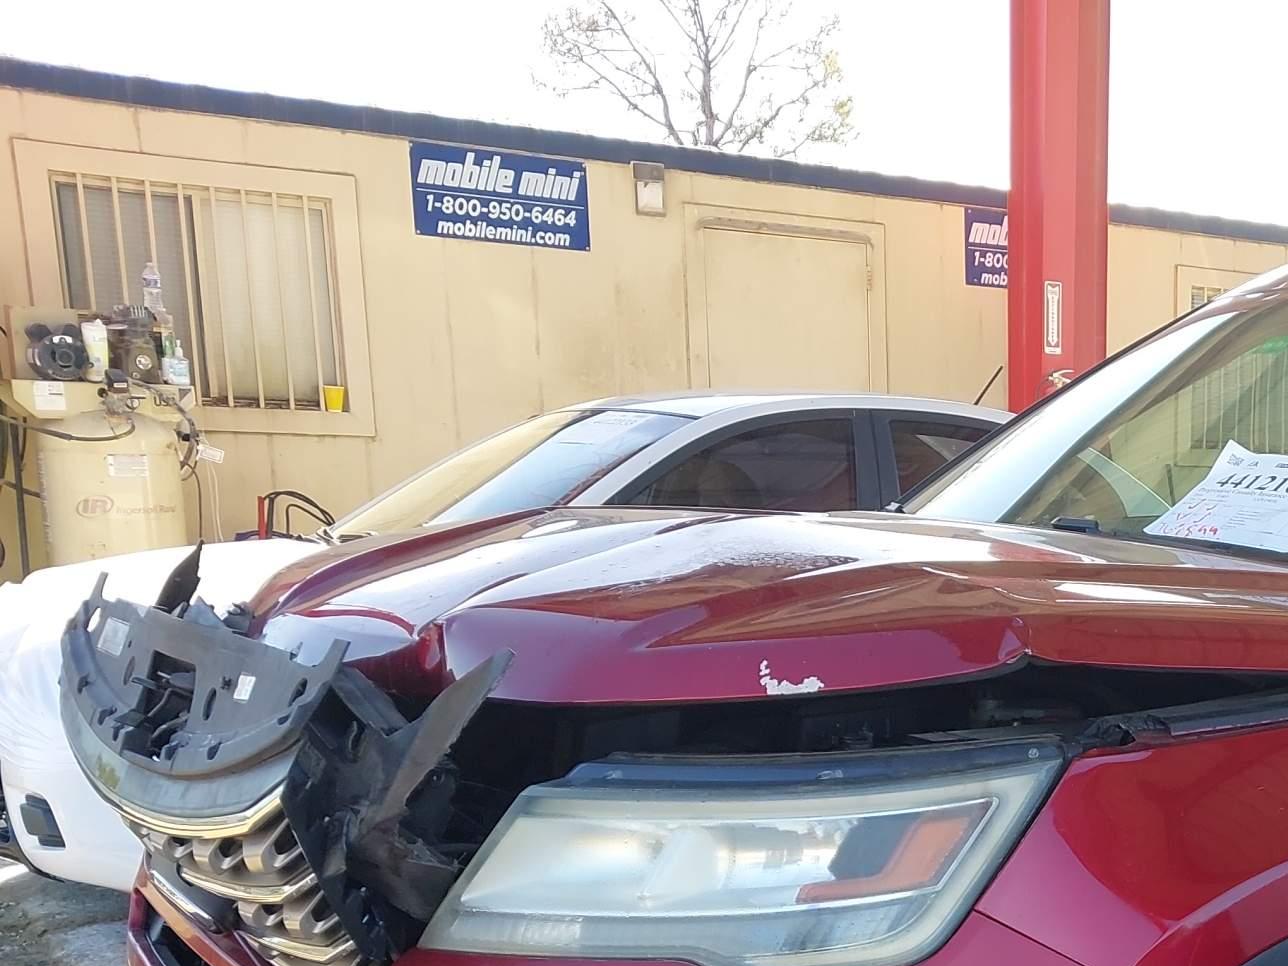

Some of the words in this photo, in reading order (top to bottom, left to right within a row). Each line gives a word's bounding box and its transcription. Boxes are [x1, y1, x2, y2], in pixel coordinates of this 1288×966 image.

[417, 152, 515, 193] mobile
[518, 168, 580, 201] mini
[425, 194, 577, 227] 1-800-950-6464
[437, 220, 571, 246] mobilemini.com
